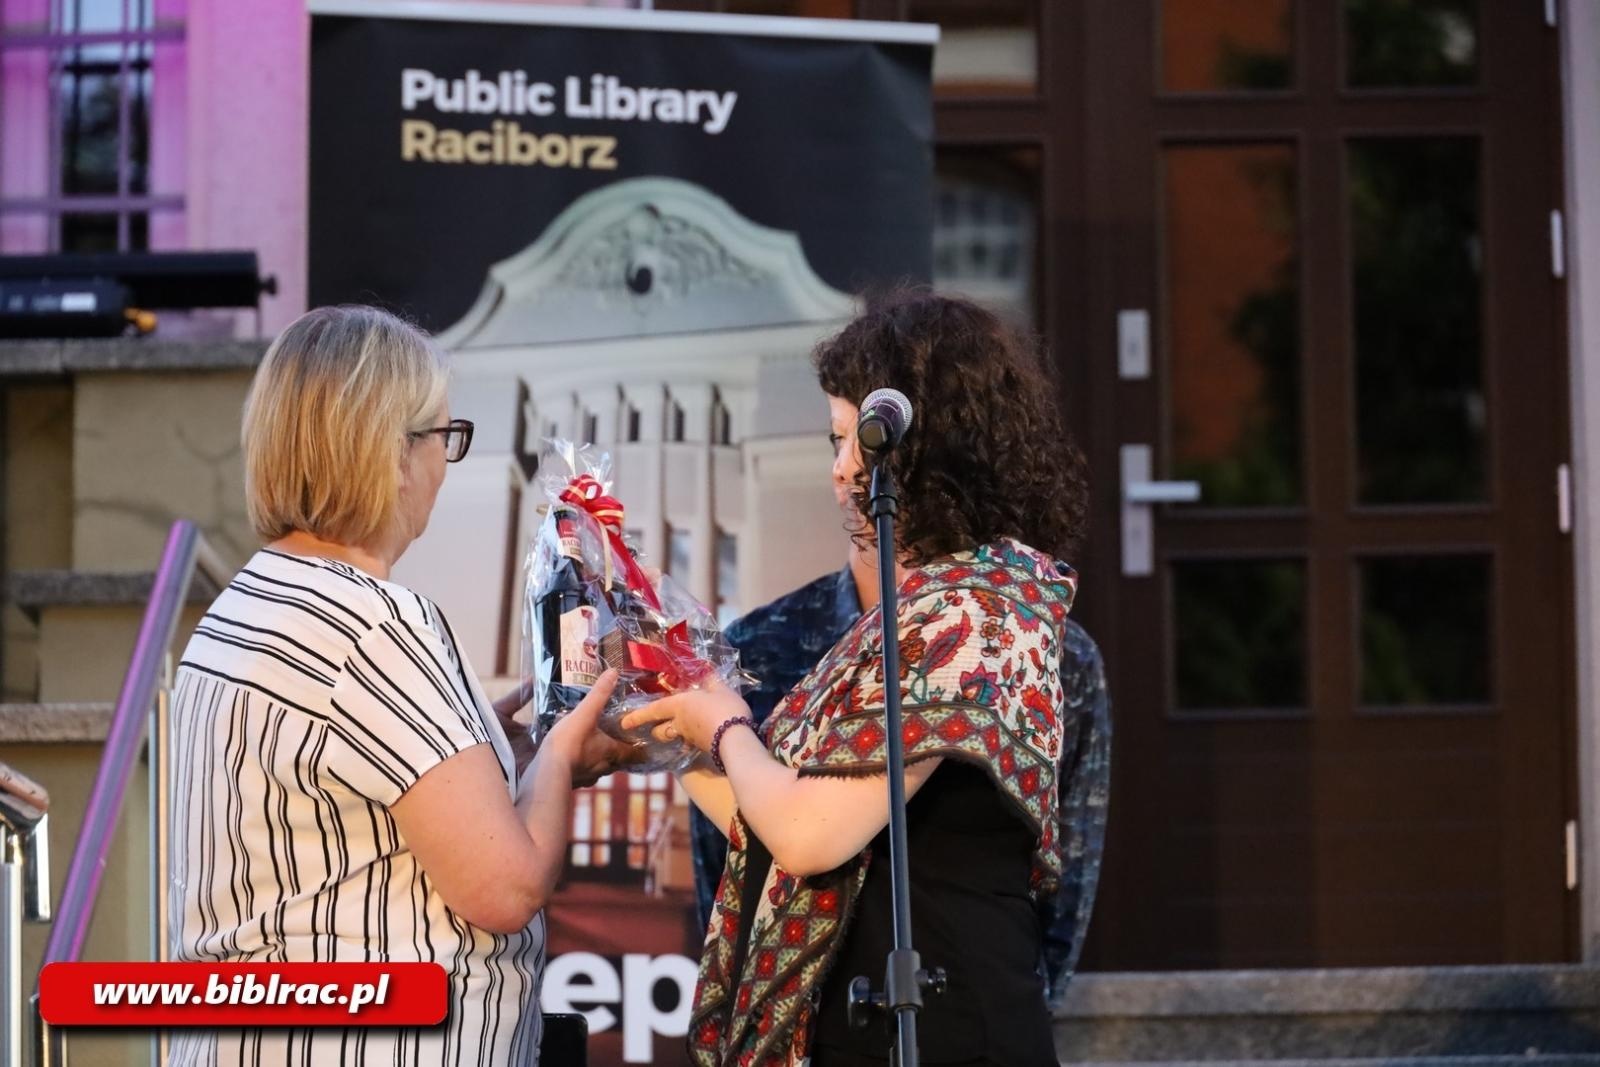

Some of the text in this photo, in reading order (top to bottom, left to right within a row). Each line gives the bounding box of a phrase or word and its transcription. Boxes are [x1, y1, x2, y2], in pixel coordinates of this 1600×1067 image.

[402, 69, 737, 134] Public Library
[402, 121, 618, 169] Raciborz
